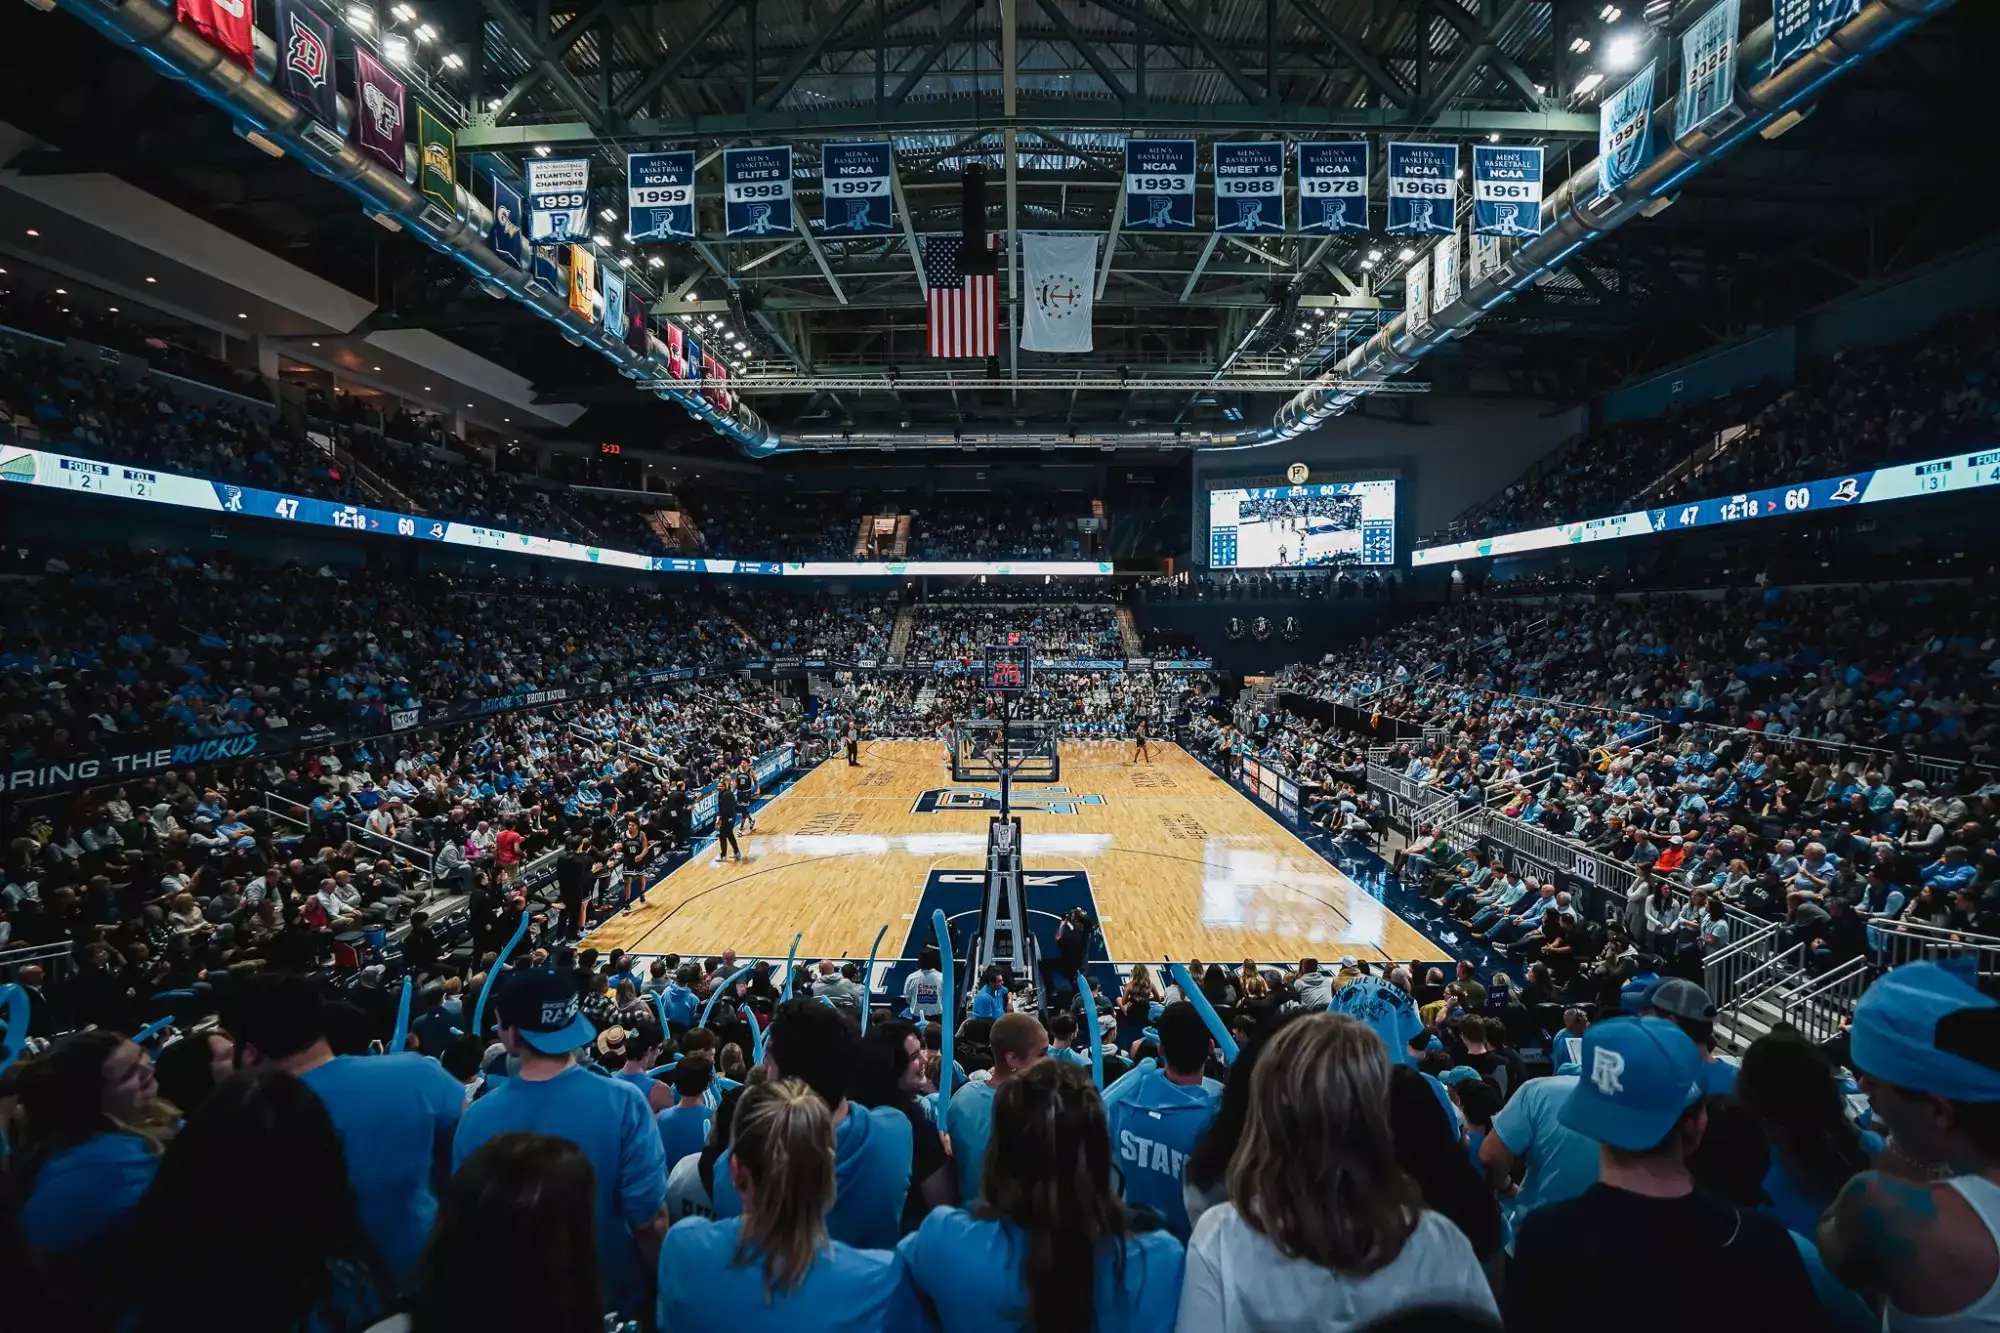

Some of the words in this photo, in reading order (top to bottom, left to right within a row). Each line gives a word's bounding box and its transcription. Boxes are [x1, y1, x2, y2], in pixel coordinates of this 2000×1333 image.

[1689, 45, 1728, 86] 2022
[1613, 105, 1638, 127] NCAA
[1607, 115, 1646, 150] 1996
[840, 166, 873, 175] NCAA
[1142, 162, 1177, 171] NCAA
[1219, 165, 1260, 174] SWEET
[1264, 165, 1277, 173] 16
[1316, 165, 1350, 174] NCAA
[1405, 166, 1439, 175] NCAA
[1490, 169, 1524, 178] NCAA
[645, 175, 677, 184] NCAA
[737, 171, 769, 179] ELITE
[771, 169, 780, 177] 8
[832, 181, 883, 194] 1997
[1134, 178, 1186, 190] 1993
[1223, 181, 1275, 193] 1988
[1307, 180, 1360, 193] 1978
[1396, 181, 1447, 195] 1966
[637, 190, 686, 203] 1999
[734, 184, 784, 199] 1998
[1483, 185, 1530, 198] 1961
[537, 194, 583, 208] 1999
[69, 461, 103, 475] FOULS
[82, 475, 91, 488] 2
[138, 484, 145, 496] 2
[1930, 477, 1938, 490] 3
[1990, 467, 2000, 481] 4
[1264, 488, 1277, 499] 47
[1320, 484, 1335, 496] 60
[275, 498, 299, 519] 47
[1680, 506, 1699, 525] 47
[1720, 500, 1758, 521] 12:18
[1785, 488, 1810, 511] 60
[332, 511, 366, 530] 12:18
[398, 518, 415, 536] 60
[652, 673, 668, 684] BRING
[526, 691, 545, 704] RHODY
[547, 688, 567, 700] NATION
[112, 749, 171, 772] THE
[170, 733, 259, 765] RUCKUS
[700, 792, 717, 813] KENT
[794, 812, 841, 836] RYAN
[1577, 856, 1595, 878] 112
